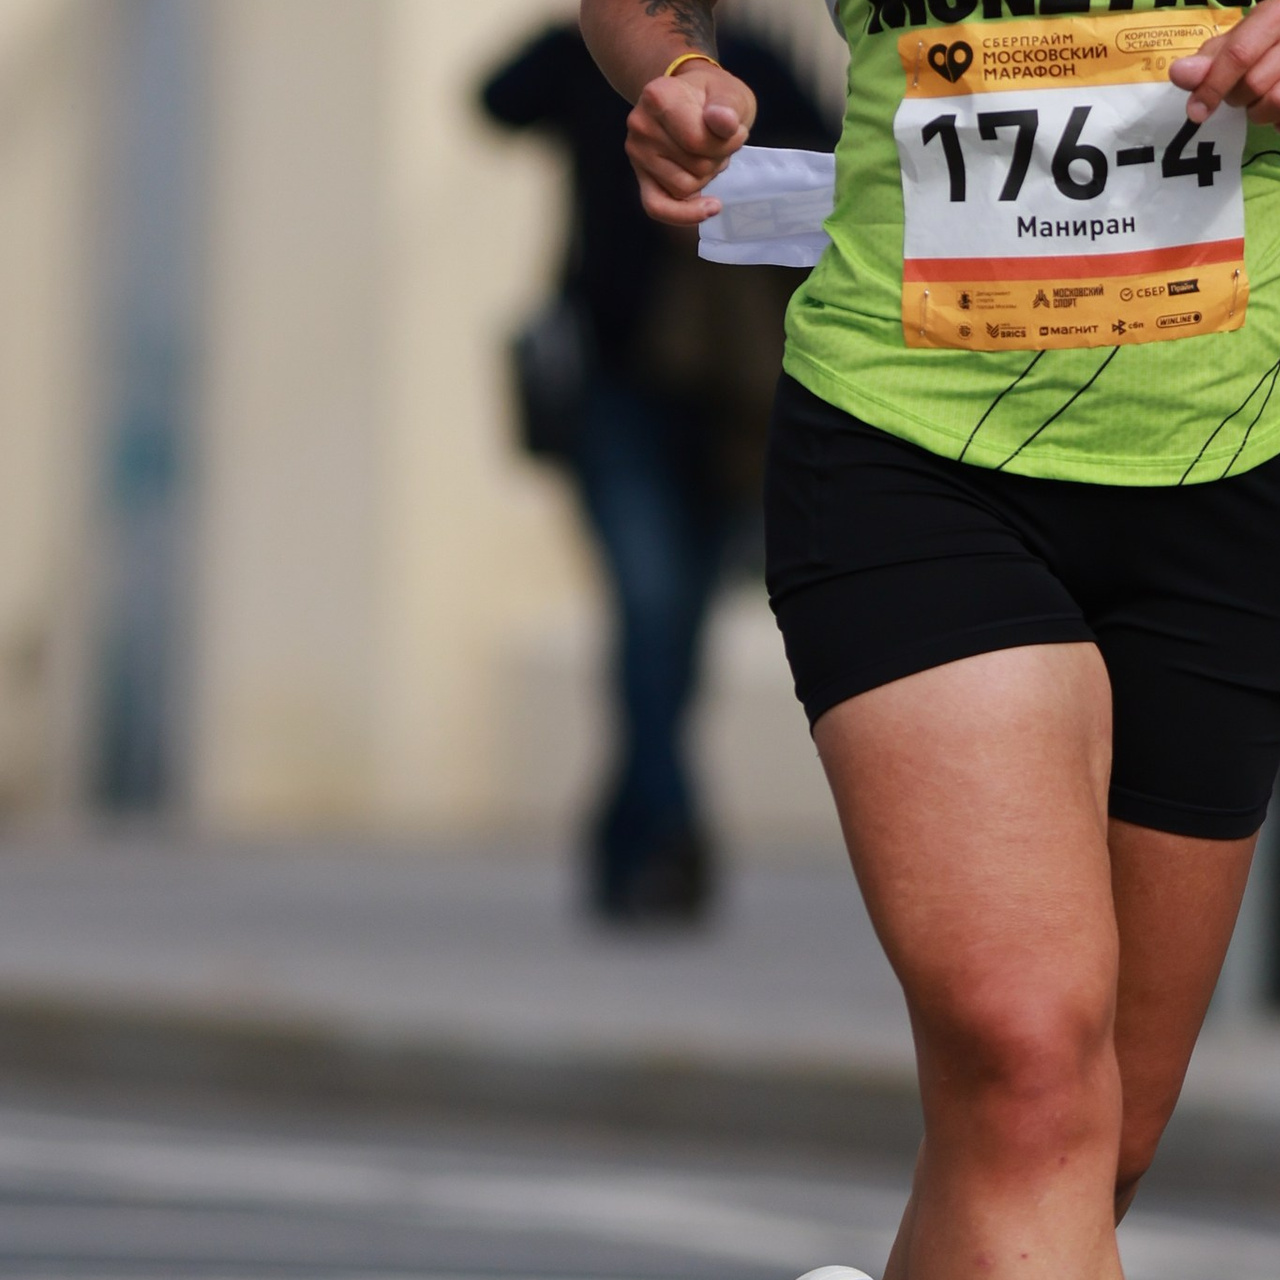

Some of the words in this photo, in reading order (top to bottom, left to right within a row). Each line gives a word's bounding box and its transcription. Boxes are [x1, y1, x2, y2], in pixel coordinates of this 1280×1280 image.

[982, 33, 1074, 49] СБЕРПРАЙМ
[1124, 28, 1204, 42] КОРПОРАТИВНАЯ
[1124, 38, 1174, 50] ЭСТАФЕТА
[982, 43, 1108, 66] МОСКОВСКИЙ
[1141, 52, 1179, 72] 20
[983, 62, 1076, 82] МАРАФОН
[922, 105, 1221, 202] 176-4
[1016, 216, 1136, 241] Маниран
[1052, 284, 1105, 298] МОСКОВСКИЙ
[1136, 285, 1166, 299] СБЕР
[1160, 314, 1192, 326] WINLINE
